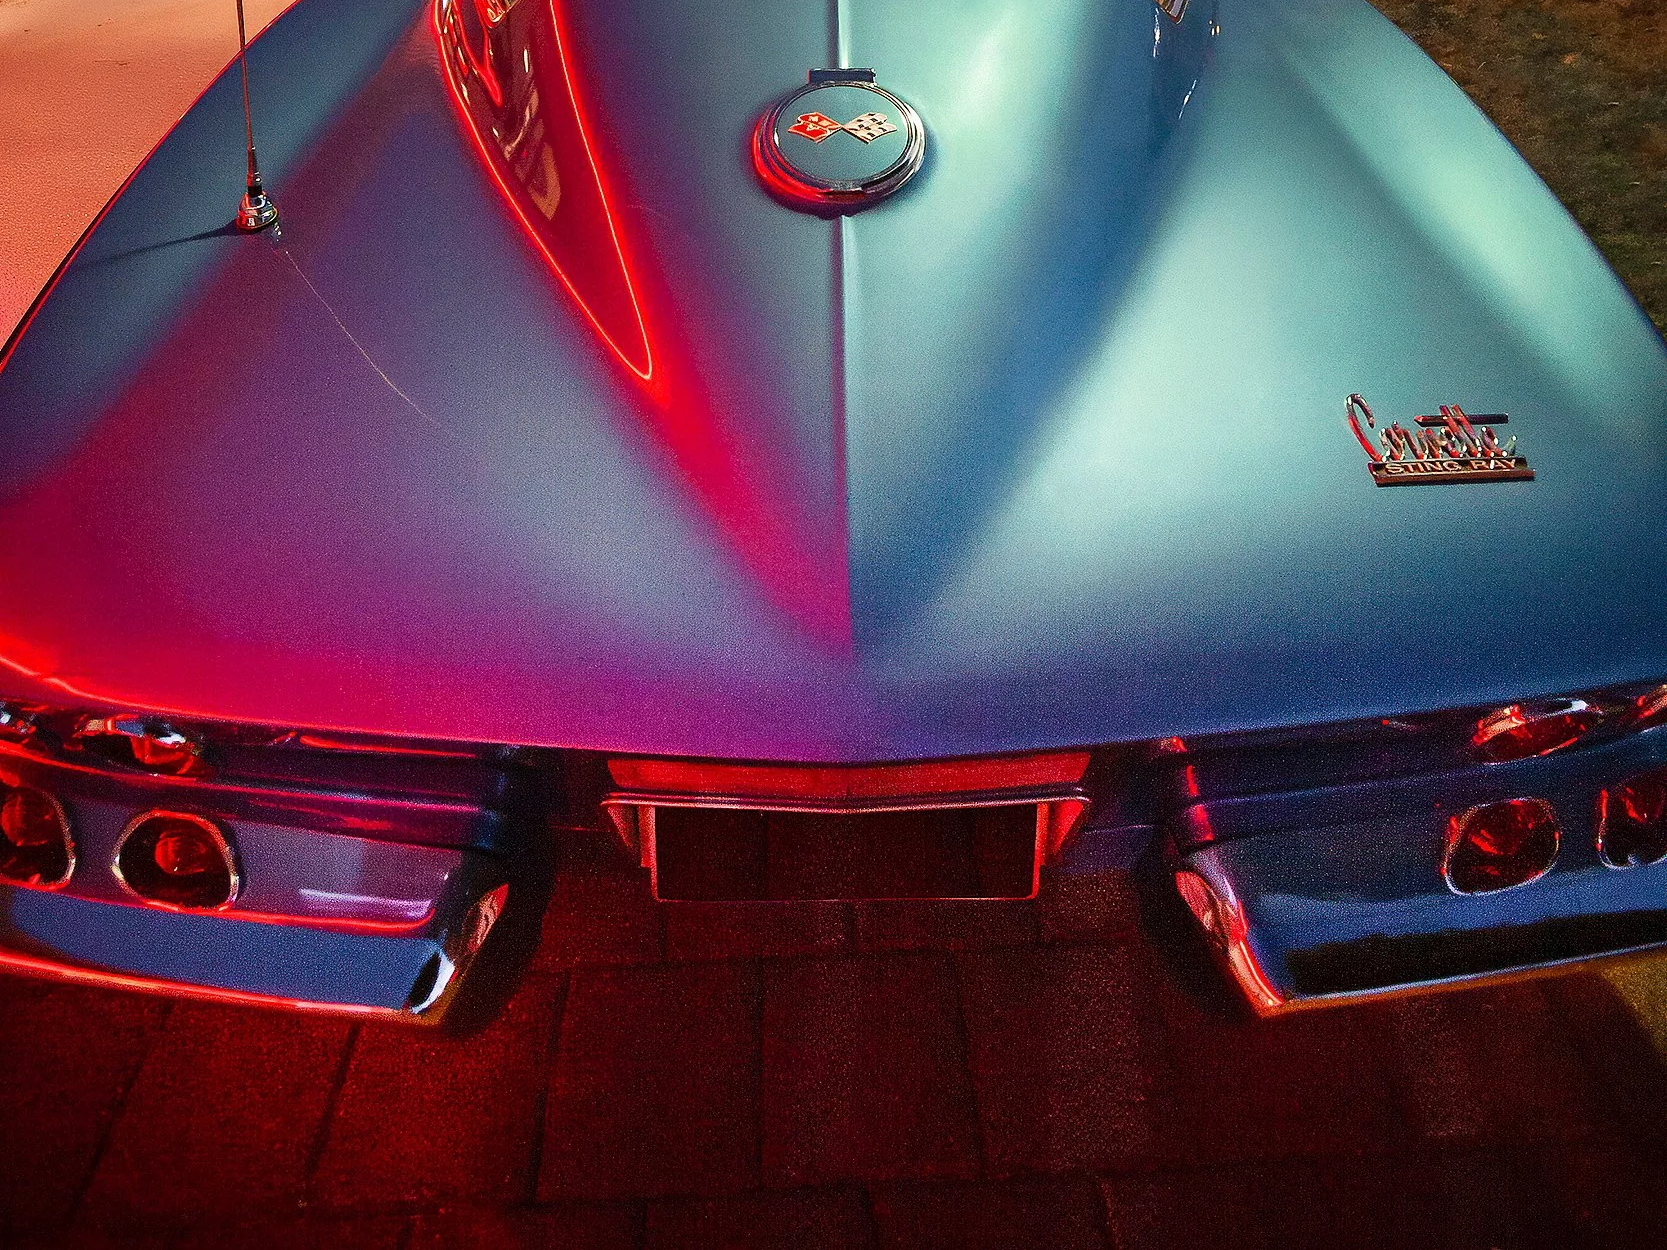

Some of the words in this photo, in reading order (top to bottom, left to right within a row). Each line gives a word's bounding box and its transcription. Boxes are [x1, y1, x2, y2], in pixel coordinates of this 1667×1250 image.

[1344, 393, 1517, 462] Corvette
[1385, 461, 1462, 475] STING
[1469, 458, 1517, 470] RAY
